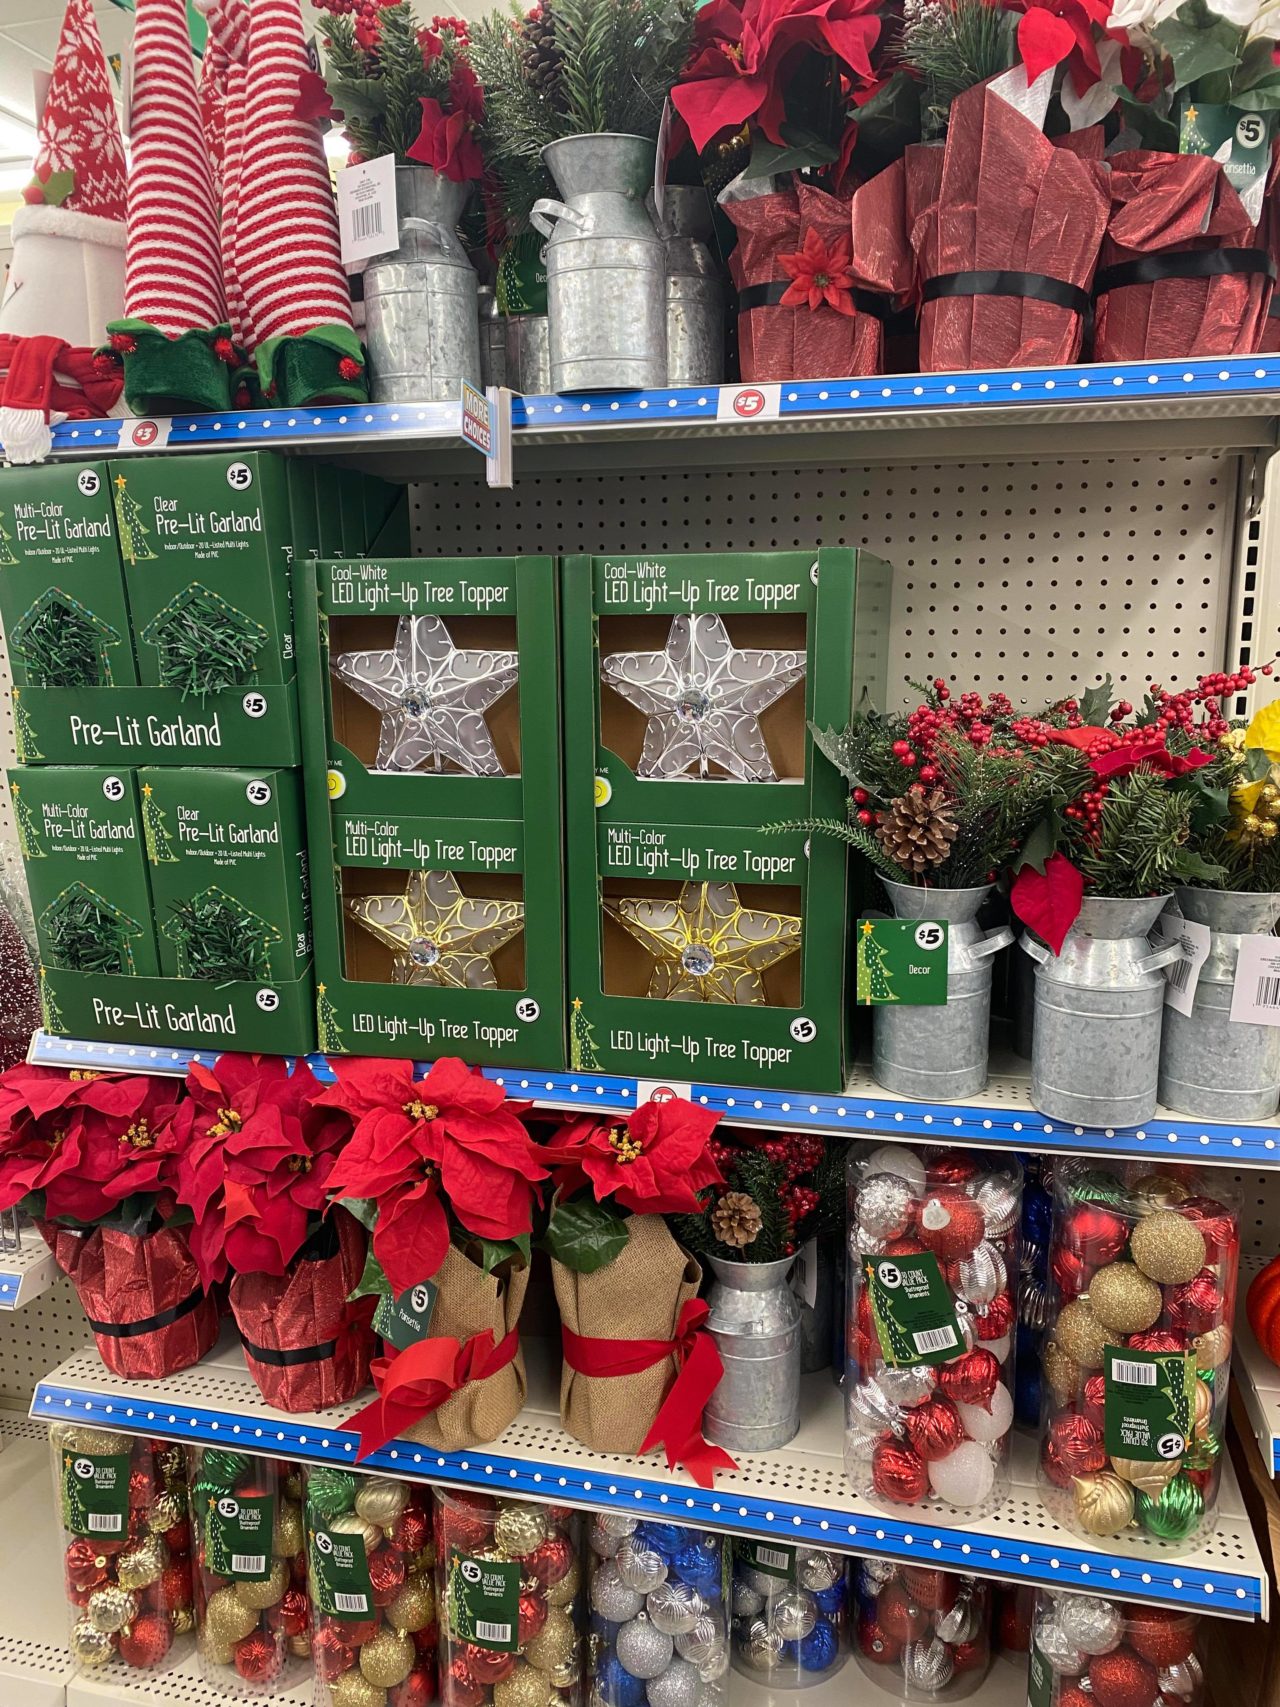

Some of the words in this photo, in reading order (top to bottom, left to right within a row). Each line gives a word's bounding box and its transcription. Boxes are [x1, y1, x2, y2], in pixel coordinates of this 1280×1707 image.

[1239, 120, 1261, 142] $5
[1223, 162, 1256, 175] oinsettia
[466, 388, 489, 425] MORE
[736, 396, 759, 411] $5
[136, 427, 153, 441] $3
[464, 416, 491, 450] CHOICES
[80, 476, 97, 491] $5
[230, 468, 249, 485] $5
[14, 501, 63, 519] Multi-Color
[154, 496, 178, 512] Clear
[17, 519, 61, 541] Pre-Lit
[64, 513, 111, 539] Garland
[156, 512, 206, 535] Pre-Lit
[210, 507, 262, 534] Garland
[331, 565, 387, 581] Cool-White
[604, 562, 666, 579] Cool-White
[331, 583, 353, 603] LED
[358, 581, 419, 611] Light-Up
[423, 581, 454, 602] Tree
[459, 581, 509, 611] Topper
[604, 581, 628, 603] LED
[633, 579, 700, 611] Light-Up
[706, 579, 739, 602] Tree
[745, 578, 800, 610] Topper
[282, 633, 293, 660] Clear
[245, 698, 264, 713] $5
[70, 715, 142, 746] Pre-Lit
[147, 712, 222, 746] Garland
[105, 780, 122, 796] $5
[249, 785, 268, 801] $5
[42, 803, 88, 818] Multi-Color
[177, 805, 199, 821] Clear
[44, 819, 86, 838] Pre-Lit
[89, 817, 135, 839] Garland
[178, 822, 224, 842] Pre-Lit
[228, 821, 279, 843] Garland
[345, 820, 399, 837] Multi-Color
[608, 828, 666, 845] Multi-Color
[345, 836, 367, 856] LED
[371, 837, 430, 866] Light-Up
[435, 839, 464, 860] Tree
[469, 841, 517, 869] Topper
[608, 845, 631, 866] LED
[636, 846, 699, 877] Light-Up
[705, 848, 737, 871] Tree
[743, 850, 796, 880] Topper
[295, 932, 306, 958] Clear
[918, 928, 940, 945] $5
[908, 964, 931, 975] Decor
[258, 994, 276, 1007] $5
[92, 997, 161, 1030] Pre-Lit
[165, 1003, 236, 1035] Garland
[518, 1002, 537, 1018] $5
[352, 1013, 374, 1033] LED
[377, 1015, 435, 1044] Light-Up
[439, 1018, 468, 1039] Tree
[473, 1020, 519, 1048] Topper
[793, 1021, 813, 1037] $5
[610, 1030, 633, 1050] LED
[637, 1032, 700, 1063] Light-Up
[705, 1037, 736, 1058] Tree
[741, 1040, 793, 1069] Topper
[881, 1268, 899, 1283] $5
[413, 1288, 426, 1308] $5
[1119, 1428, 1134, 1438] PACK
[1122, 1435, 1140, 1446] COUNT
[1134, 1430, 1151, 1440] VALUE
[1161, 1438, 1182, 1455] $5
[76, 1462, 92, 1475] $5
[220, 1502, 236, 1514] $5
[318, 1535, 331, 1550] $5
[463, 1564, 479, 1579] $5
